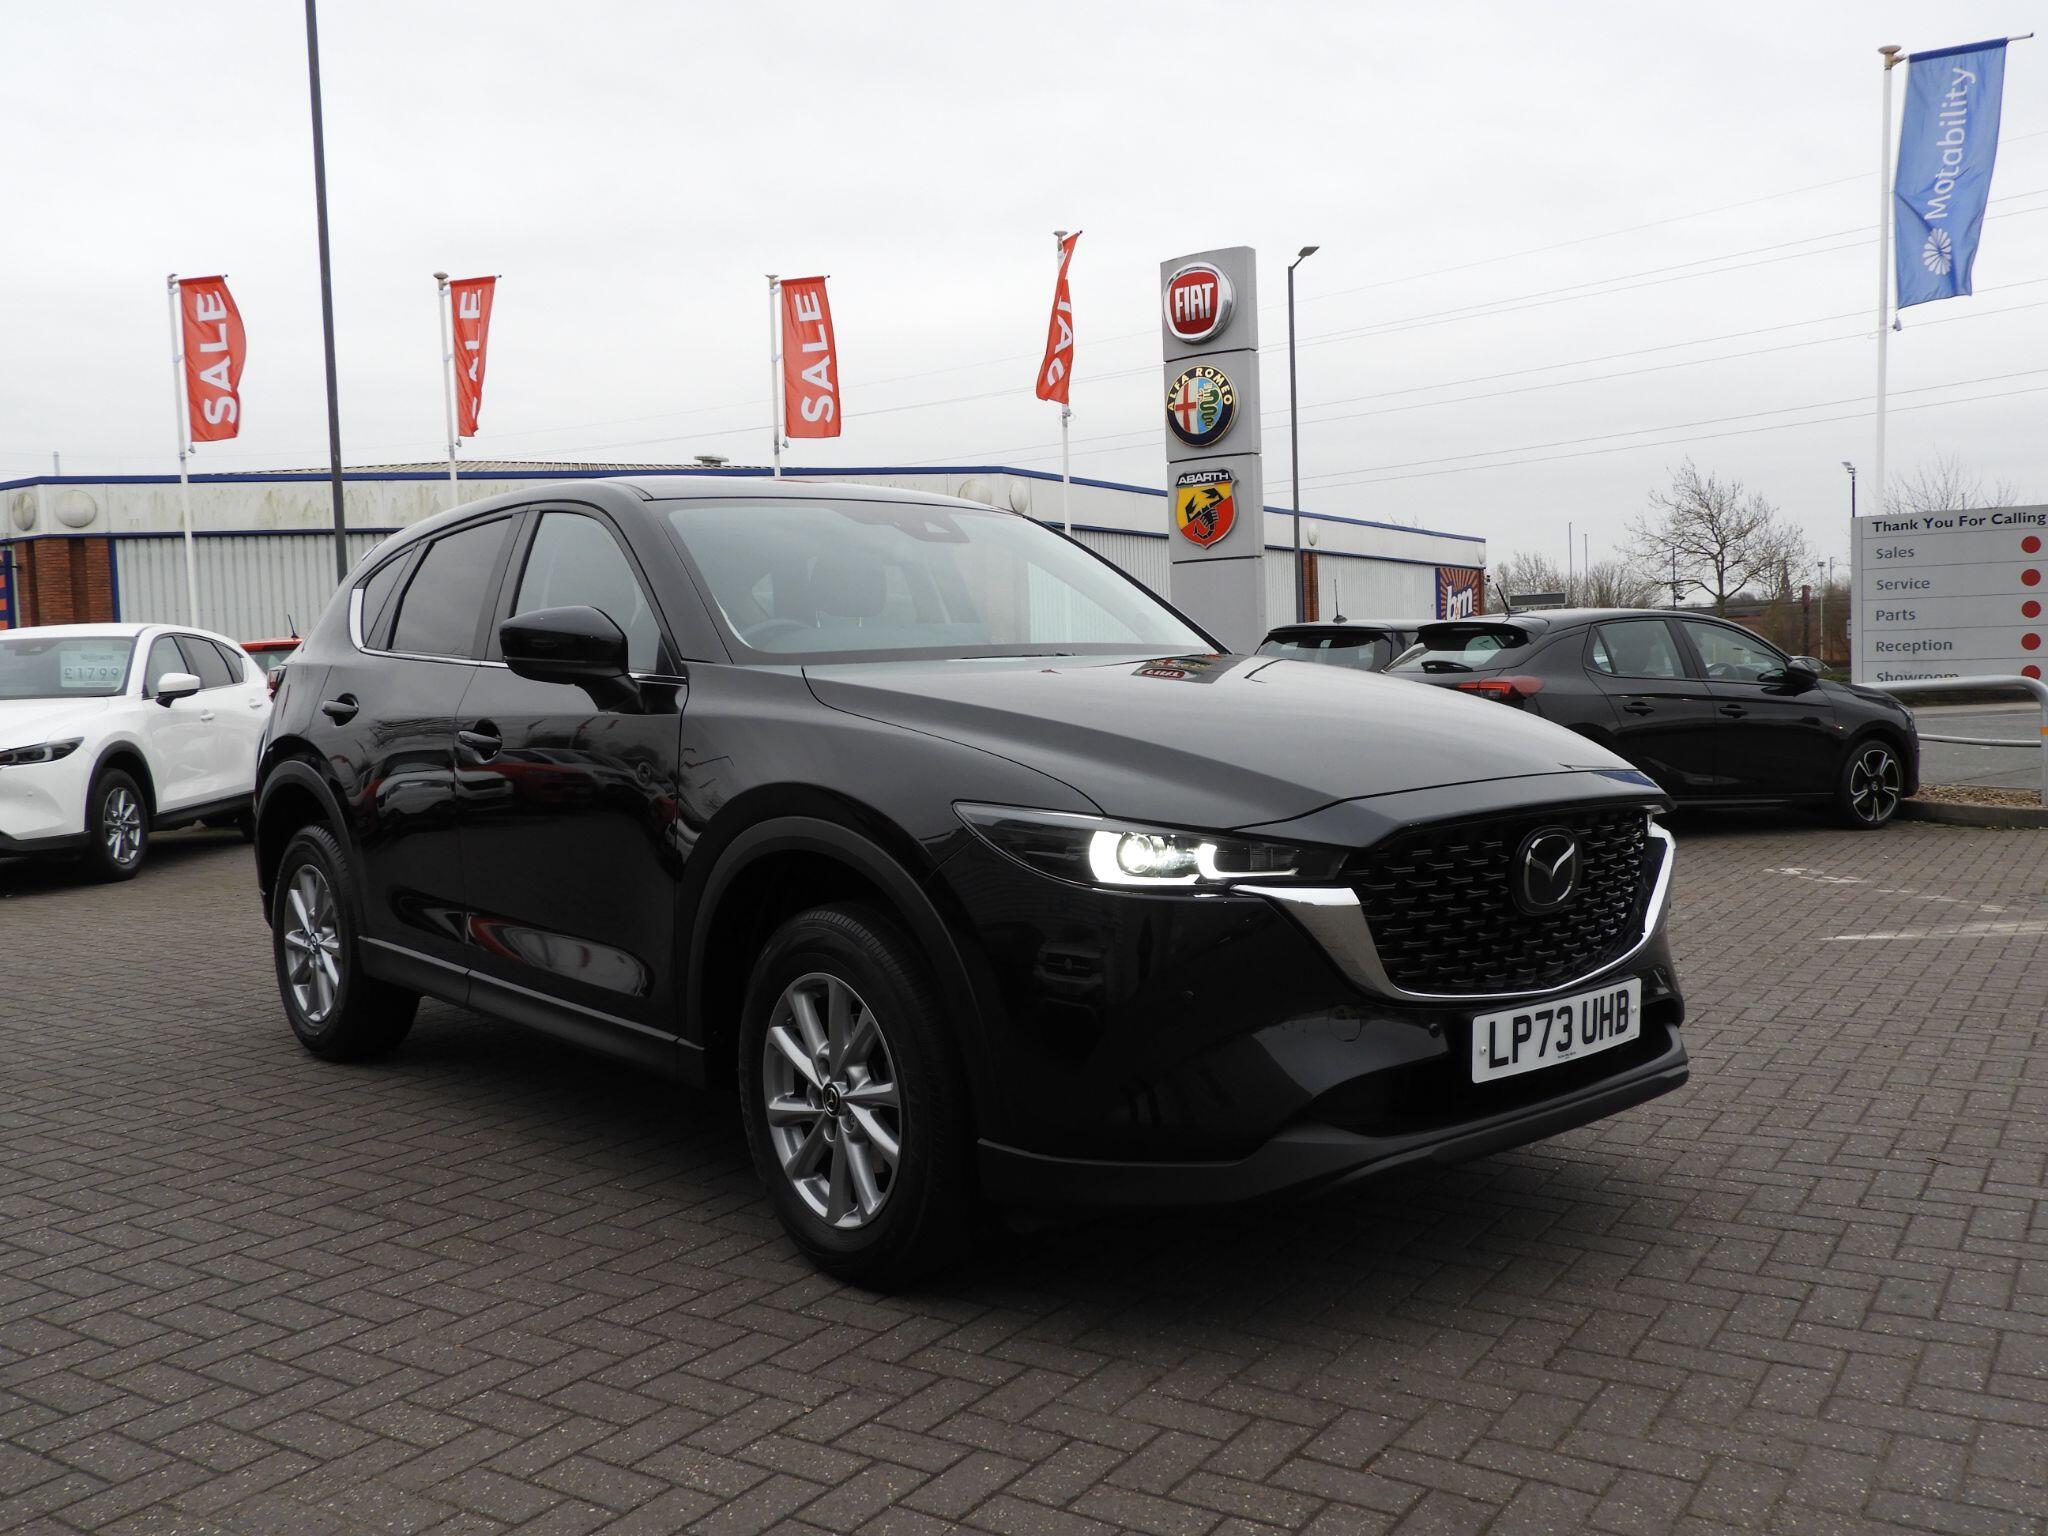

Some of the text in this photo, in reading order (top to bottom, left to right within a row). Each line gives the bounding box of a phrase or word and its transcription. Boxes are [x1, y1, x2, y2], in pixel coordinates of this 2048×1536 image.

[1925, 66, 1976, 220] Motability
[1174, 282, 1214, 322] FIAT
[196, 290, 238, 425] SALE
[795, 291, 835, 423] SALE
[1167, 367, 1233, 411] ALFA ROMEO
[1178, 472, 1229, 485] ABARTH
[1872, 511, 2047, 533] Thank You For Calling
[1875, 547, 1915, 559] Sales
[1876, 578, 1931, 591] Service
[1875, 609, 1916, 622] Parts
[1875, 639, 1953, 654] Reception
[1488, 989, 1629, 1069] LP73 UHB
